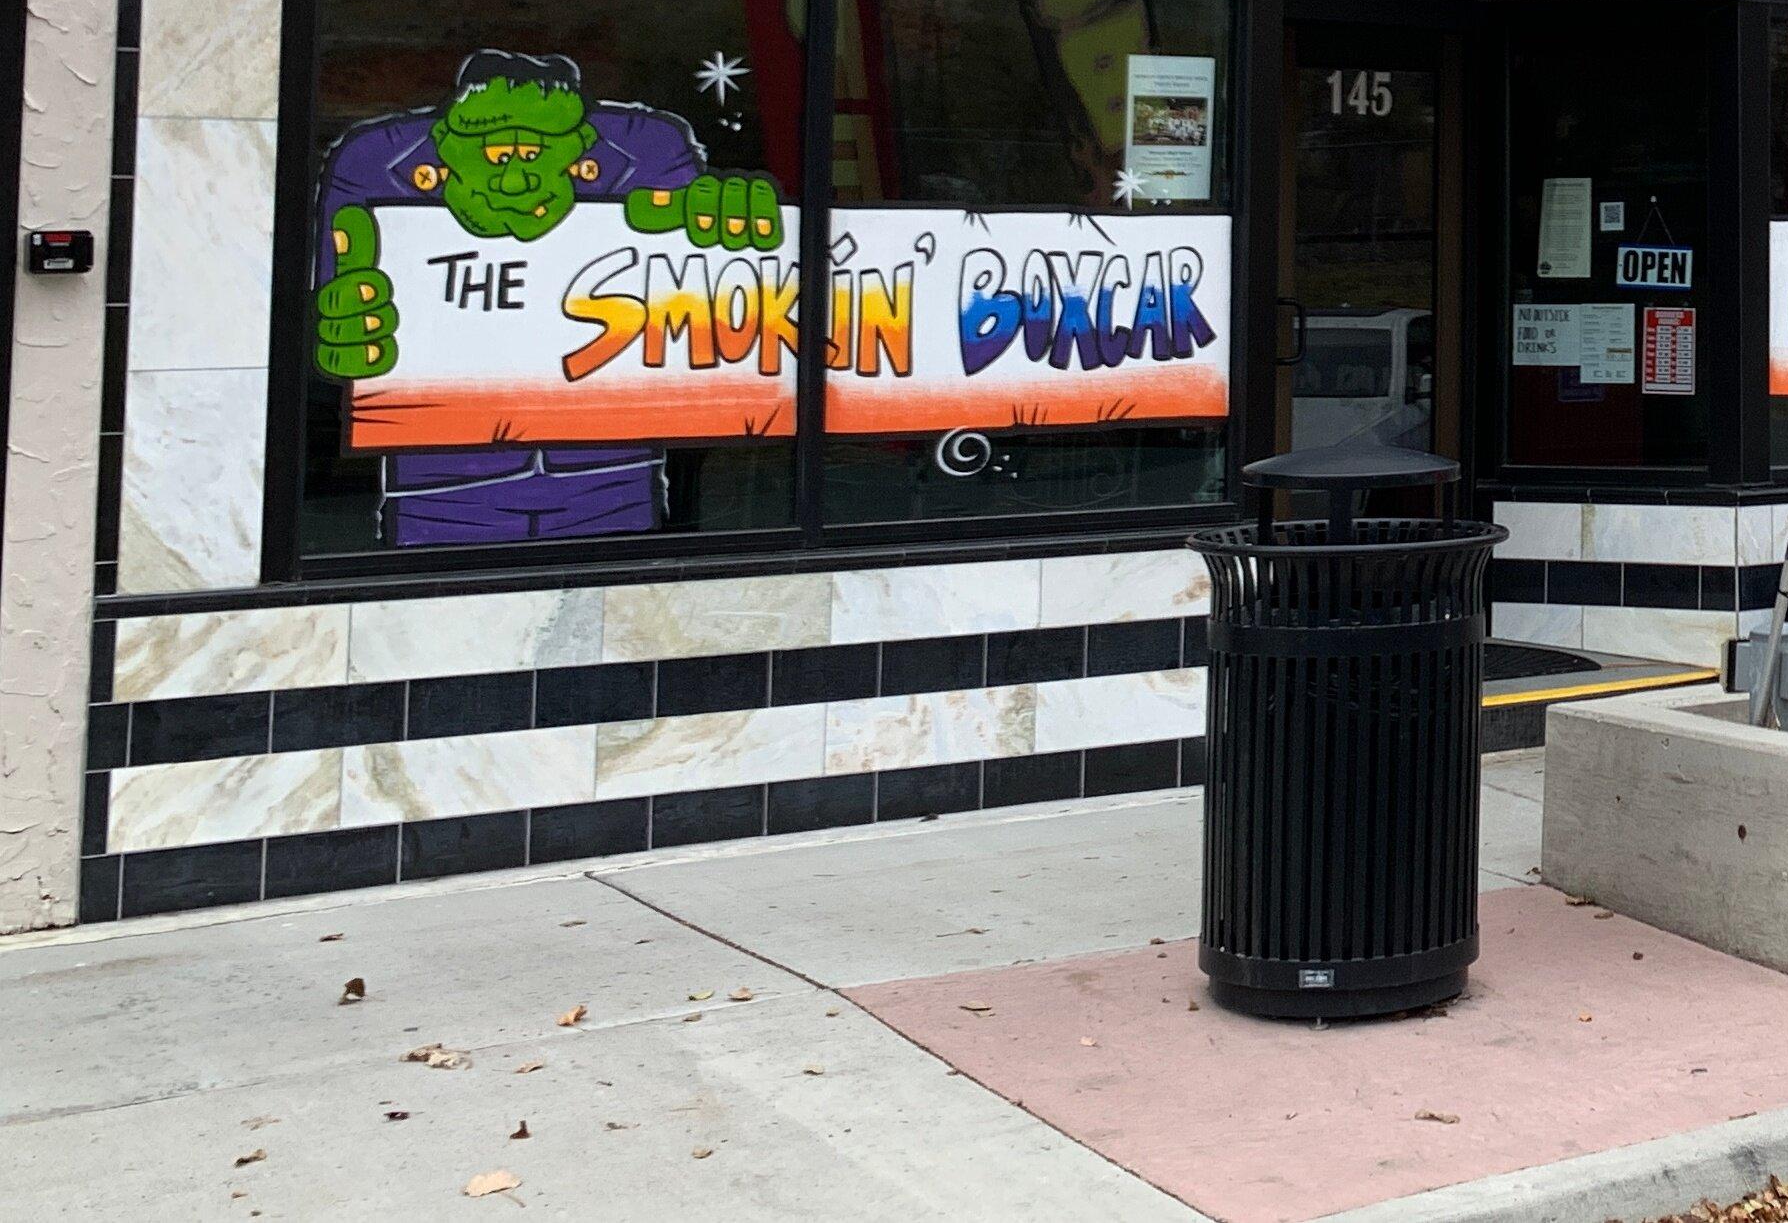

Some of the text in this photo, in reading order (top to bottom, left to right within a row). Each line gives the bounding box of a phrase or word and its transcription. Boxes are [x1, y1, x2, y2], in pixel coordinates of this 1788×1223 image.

[1326, 70, 1394, 117] 145
[1622, 250, 1687, 285] OPEN
[427, 251, 527, 312] THE
[958, 246, 1218, 376] BOXCAR
[1517, 341, 1557, 354] DRINKS
